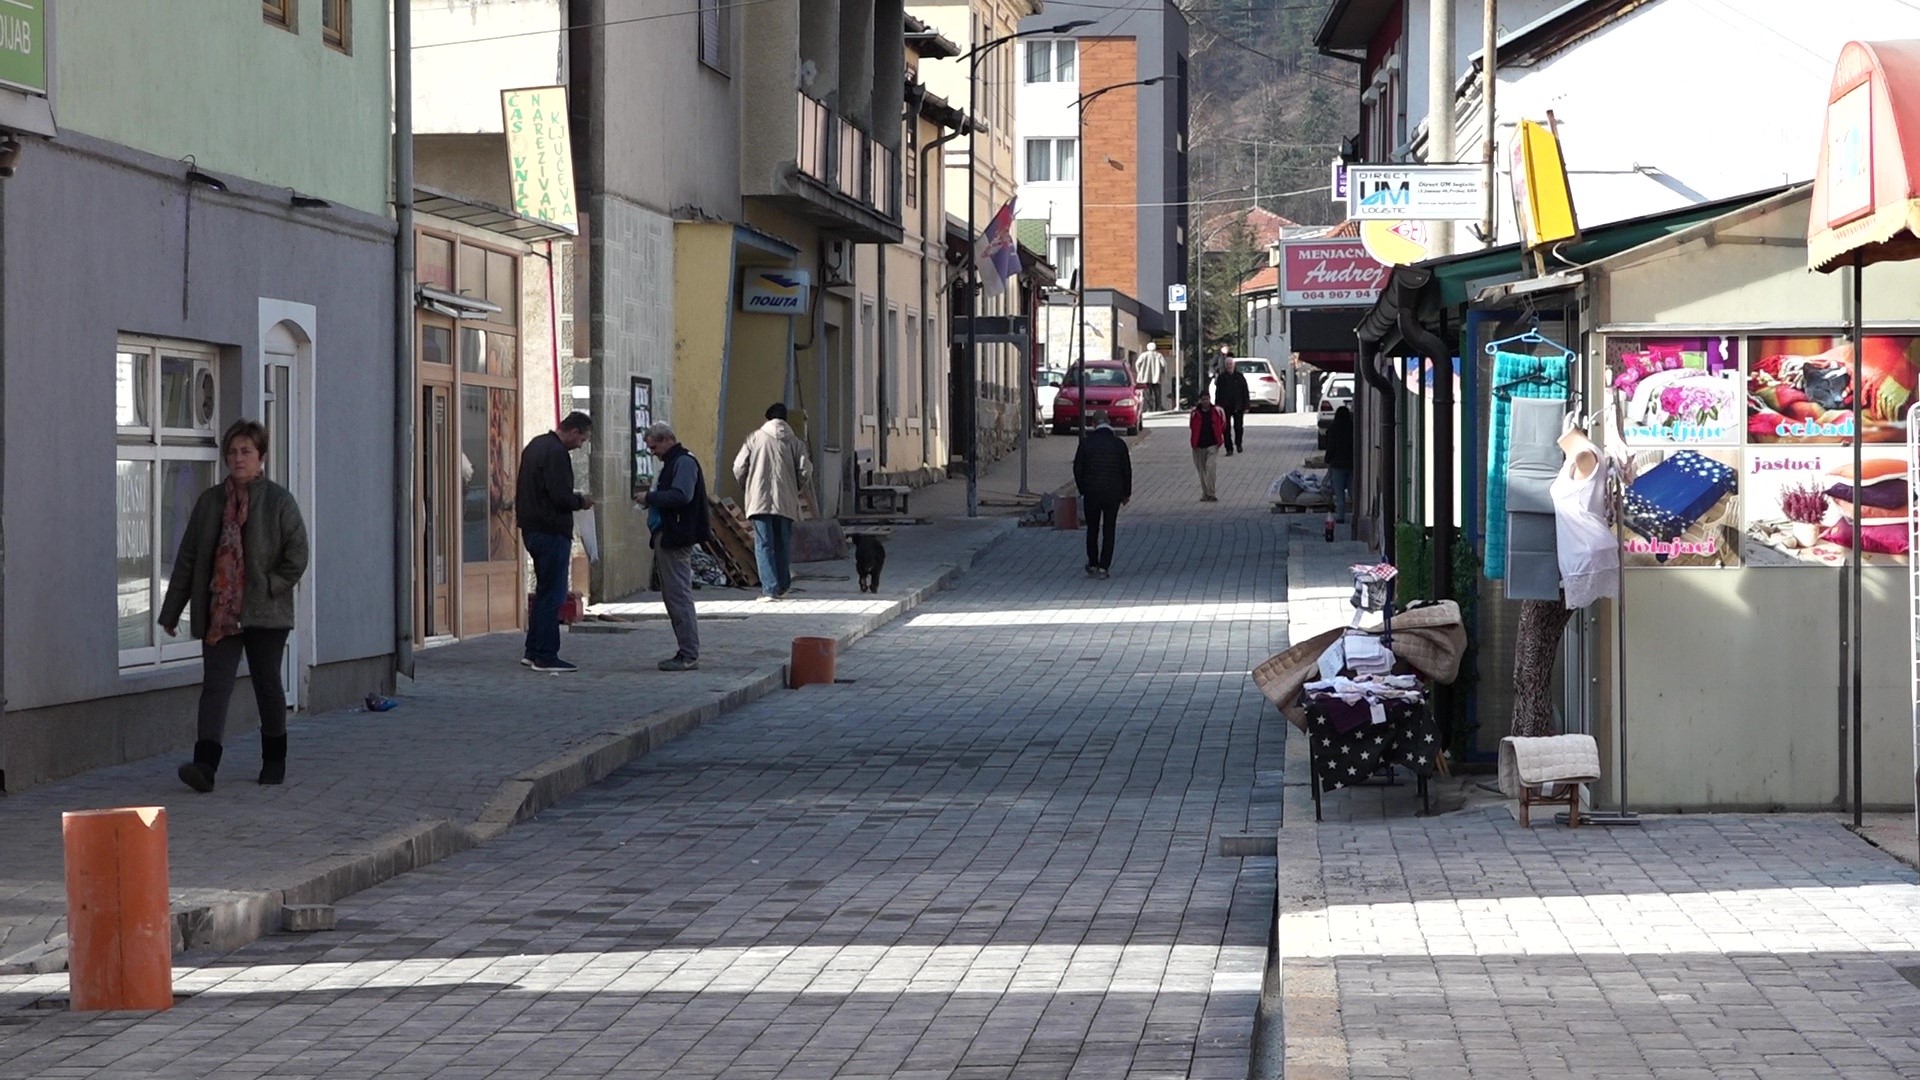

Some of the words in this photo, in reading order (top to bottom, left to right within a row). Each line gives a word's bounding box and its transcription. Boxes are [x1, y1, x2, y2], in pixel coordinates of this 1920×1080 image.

[1359, 181, 1410, 206] UM
[1303, 260, 1385, 289] Andrej
[749, 296, 798, 307] ПОШТА
[1171, 286, 1184, 301] P
[1302, 291, 1325, 300] 064
[1329, 290, 1351, 299] 967
[1355, 290, 1371, 298] 94
[1752, 456, 1821, 474] jastuci
